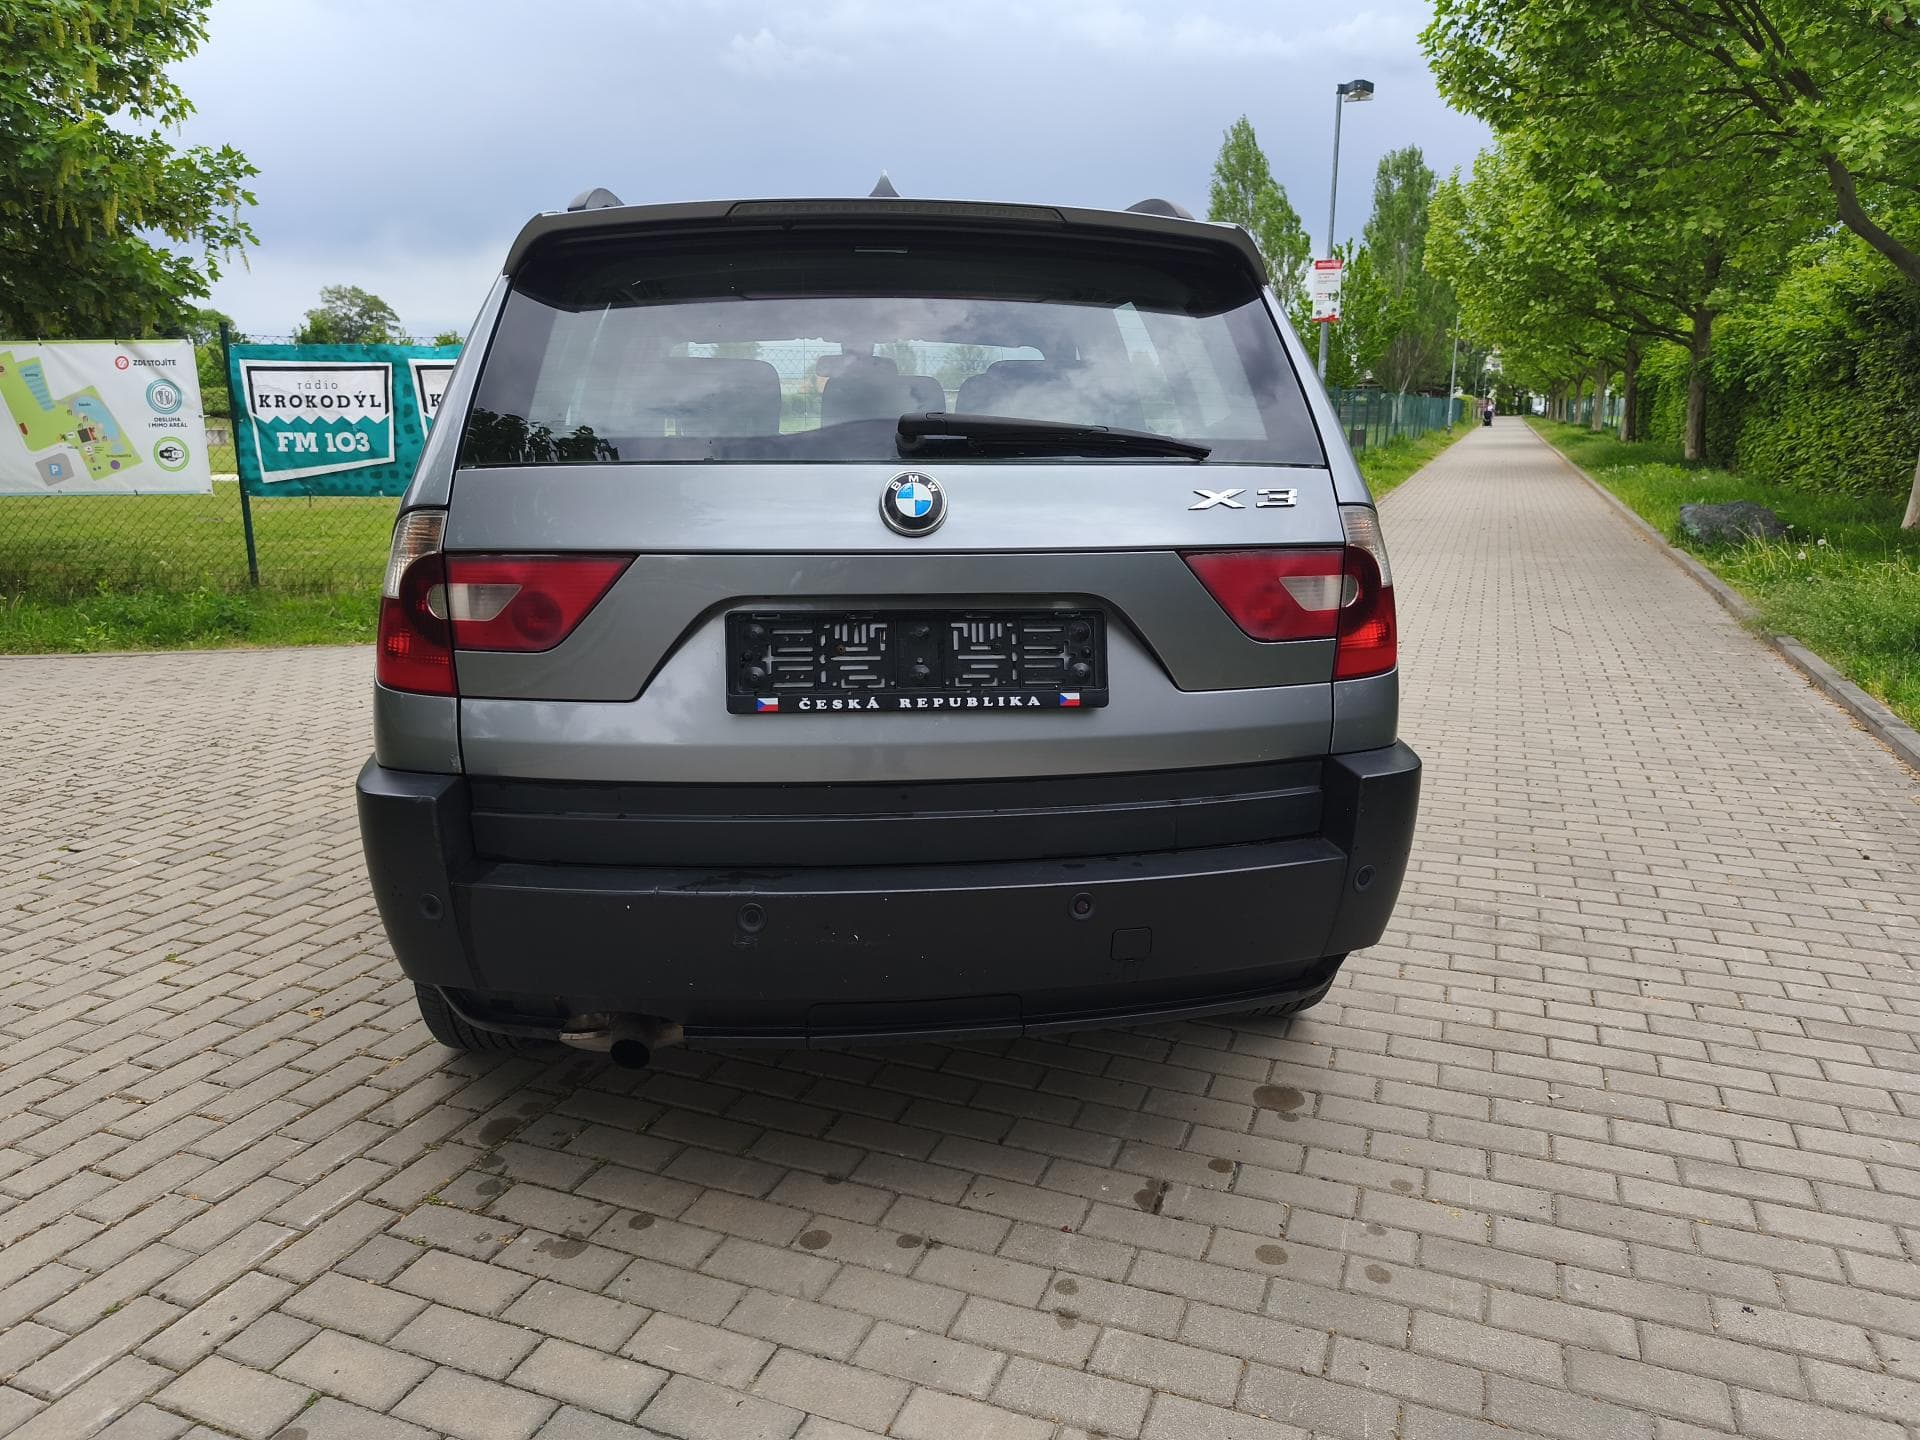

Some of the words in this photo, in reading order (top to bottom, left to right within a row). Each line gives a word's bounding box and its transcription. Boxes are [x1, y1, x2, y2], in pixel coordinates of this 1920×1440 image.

[258, 391, 382, 408] KROKODÝL
[276, 431, 319, 453] FM
[325, 431, 371, 453] 103
[890, 475, 938, 492] BMW
[1187, 488, 1298, 511] X3
[798, 697, 881, 710] ČESKÁ
[899, 695, 1042, 709] REPUBLIKA
